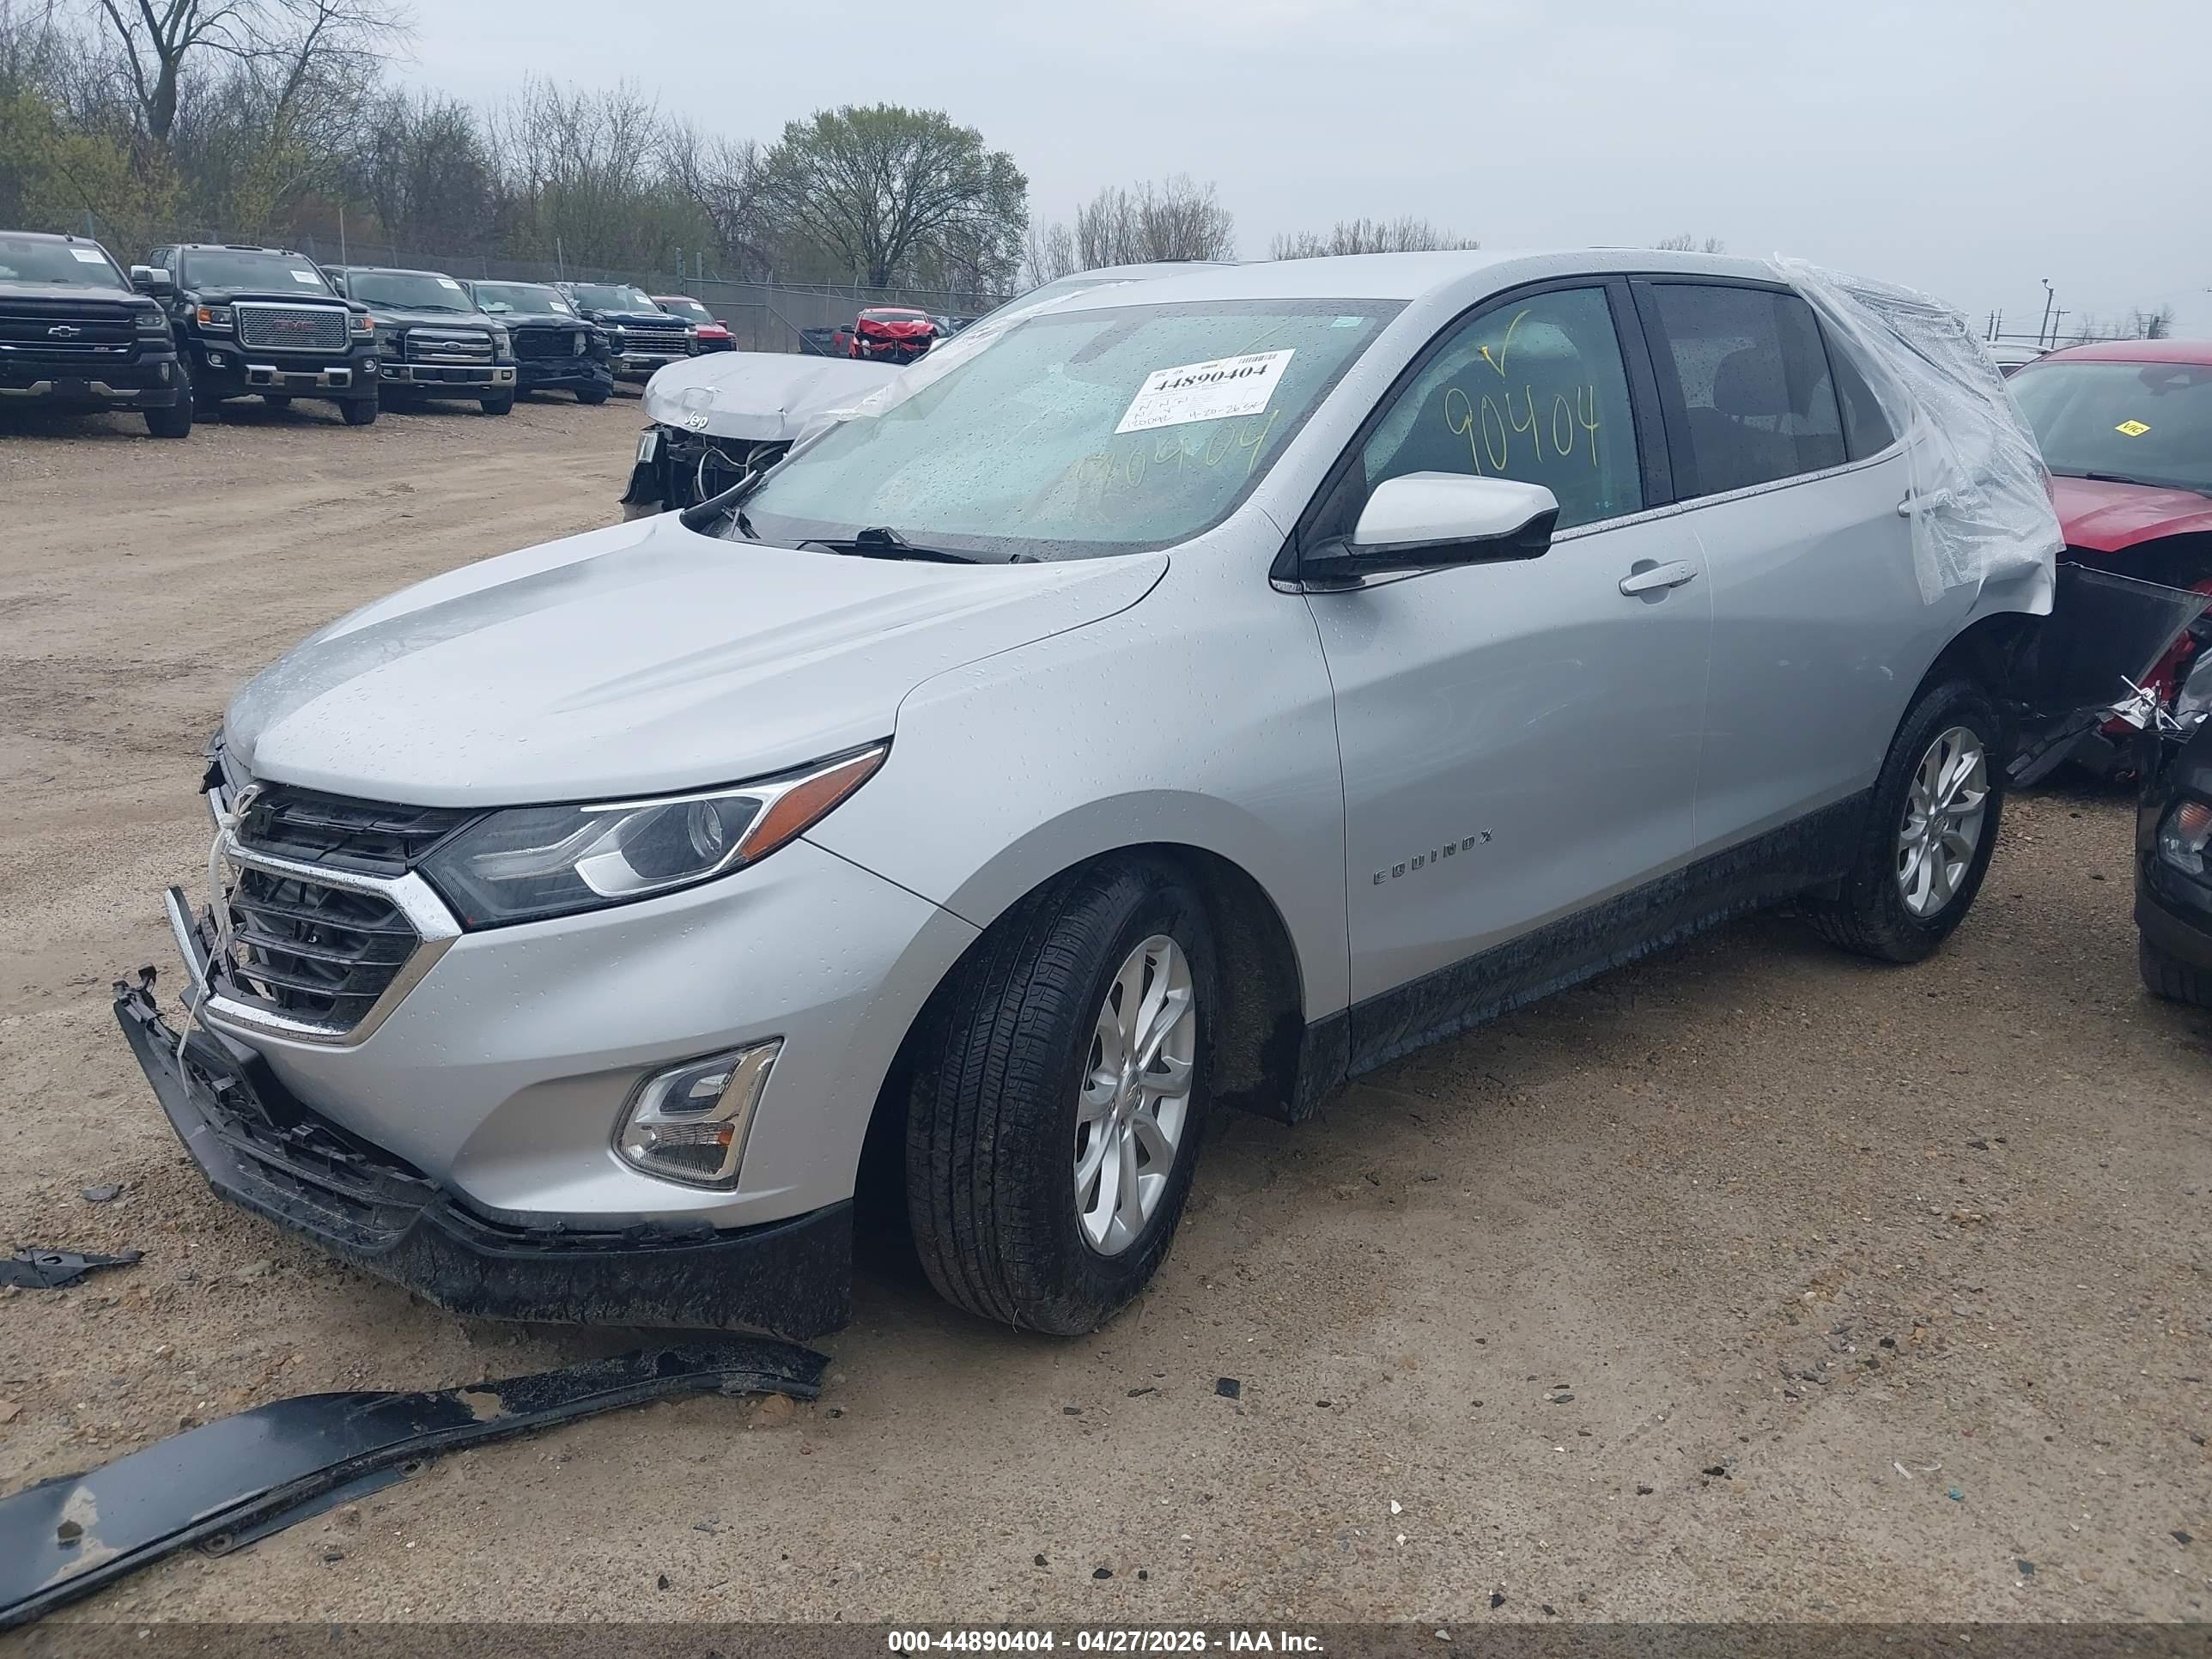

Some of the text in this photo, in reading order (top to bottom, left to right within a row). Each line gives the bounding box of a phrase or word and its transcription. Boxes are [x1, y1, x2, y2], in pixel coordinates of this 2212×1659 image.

[273, 320, 317, 331] GMC
[1154, 364, 1267, 392] 44890404
[1444, 385, 1600, 476] 90404
[1373, 827, 1493, 885] EQUINOX
